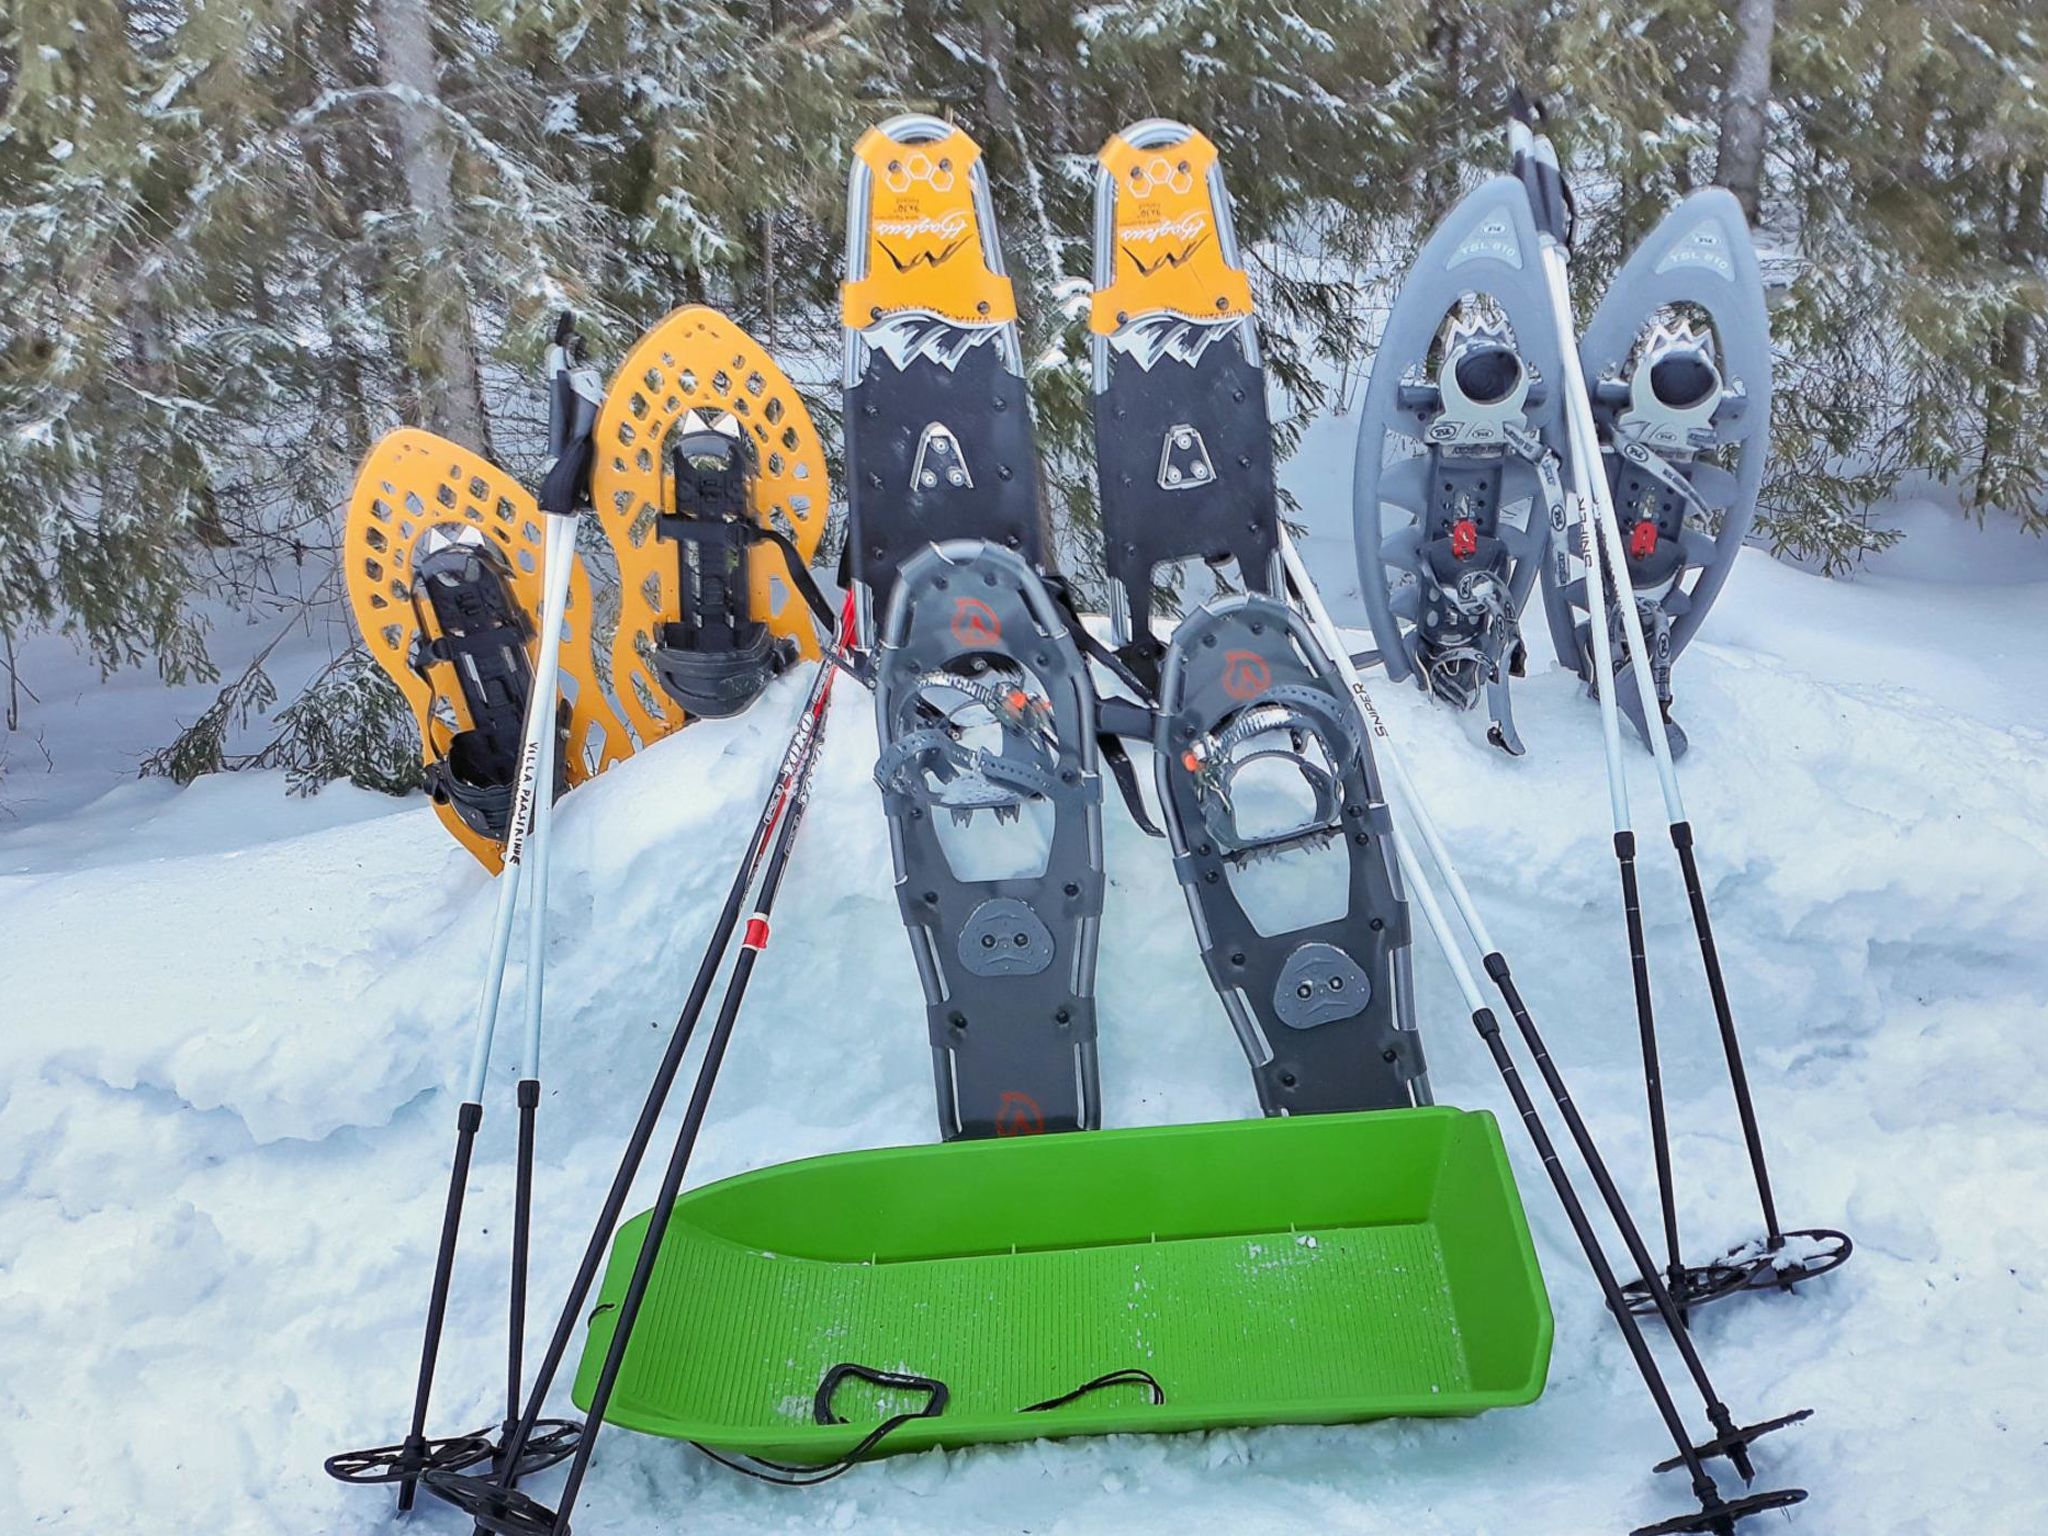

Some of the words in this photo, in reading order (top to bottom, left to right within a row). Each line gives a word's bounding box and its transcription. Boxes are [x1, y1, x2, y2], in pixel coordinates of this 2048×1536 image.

[1352, 682, 1389, 737] SNIPER
[523, 741, 539, 783] VILLA
[784, 710, 814, 778] YOKO
